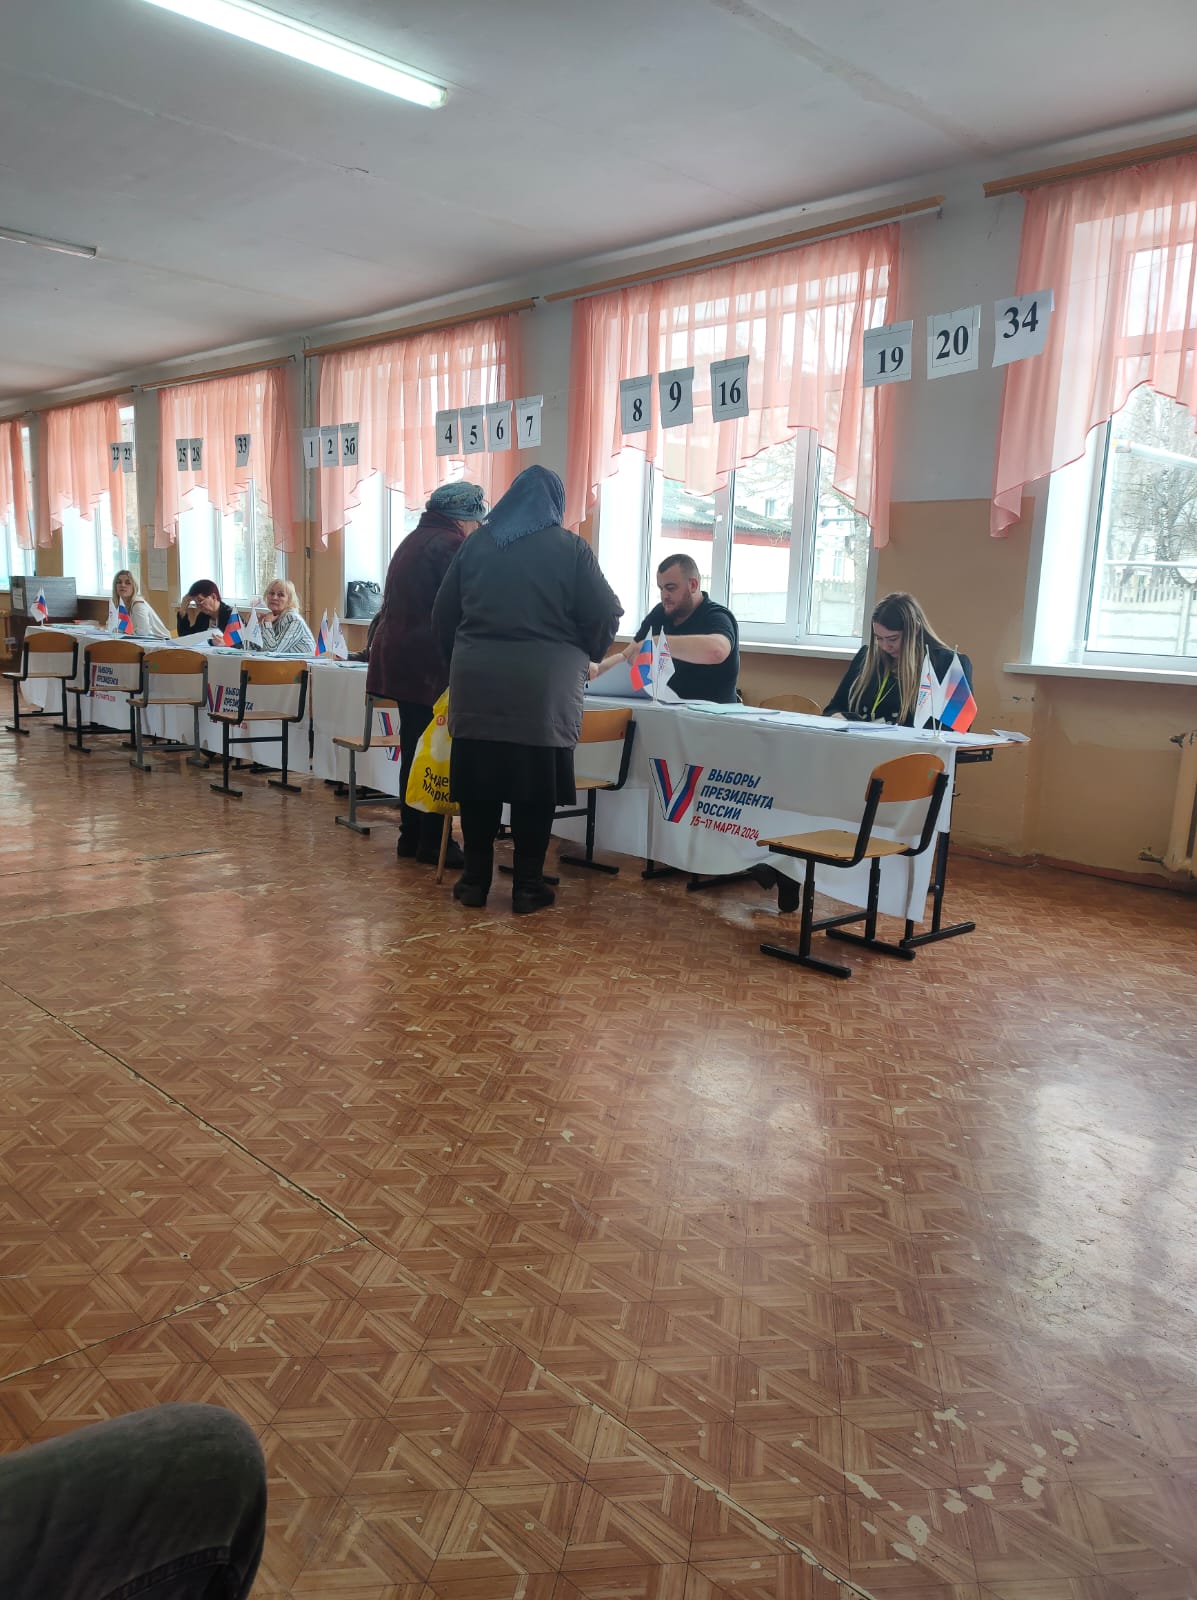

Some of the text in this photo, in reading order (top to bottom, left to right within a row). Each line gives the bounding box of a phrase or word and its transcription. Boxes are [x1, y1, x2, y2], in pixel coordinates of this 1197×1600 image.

[1002, 300, 1039, 339] 34
[935, 325, 969, 360] 20
[877, 346, 904, 375] 19
[669, 380, 682, 413] 9
[718, 377, 741, 407] 16
[632, 398, 643, 422] 8
[445, 423, 453, 444] 4
[470, 425, 478, 445] 5
[496, 418, 504, 440] 6
[526, 415, 534, 437] 7
[237, 437, 247, 454] 33
[309, 440, 314, 458] 1
[327, 438, 333, 455] 2
[424, 766, 449, 788] Янде
[707, 768, 761, 789] ВЫБОРЫ
[422, 779, 451, 802] Марк
[700, 785, 774, 810] ПРЕЗИДЕНТА
[696, 801, 742, 820] РОССИИ
[713, 820, 741, 836] МАРТА
[741, 826, 760, 841] 2024
